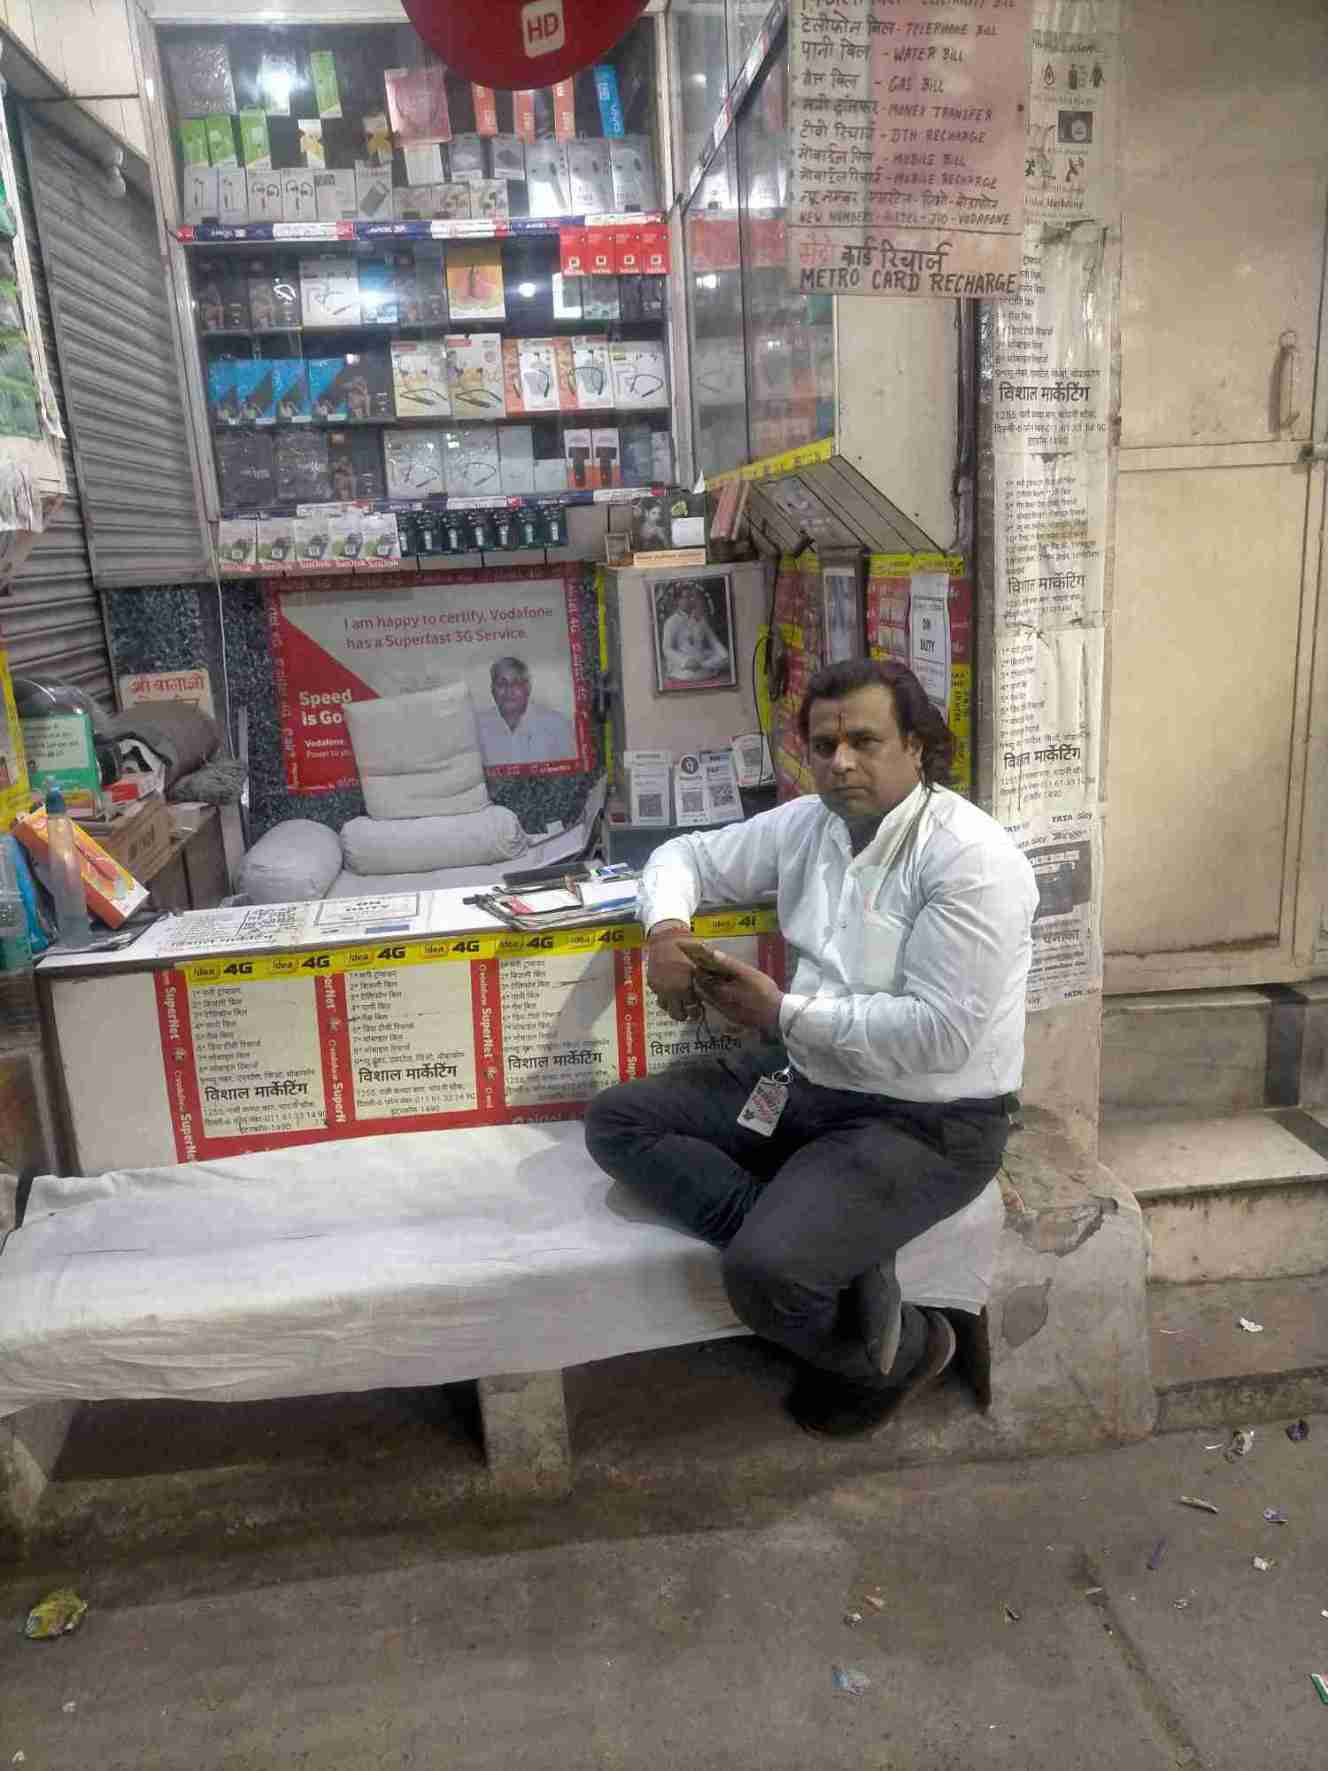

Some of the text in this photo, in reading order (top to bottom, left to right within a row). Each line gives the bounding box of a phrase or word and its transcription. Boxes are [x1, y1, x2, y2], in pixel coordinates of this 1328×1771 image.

[528, 12, 559, 44] HD
[801, 36, 834, 60] पानी
[893, 45, 964, 62] WATER BILL
[887, 75, 945, 94] GAS BILL
[889, 127, 987, 145] DTH RECHARGE
[800, 210, 822, 223] NEW
[957, 212, 1011, 226] VODAFONE
[800, 267, 860, 290] METRO
[872, 269, 921, 292] CARD
[928, 271, 1018, 295] RECHARGE
[999, 381, 1090, 401] विशाल मार्केटिंग
[344, 617, 349, 632] I
[352, 619, 374, 631] am
[377, 614, 418, 630] happy
[423, 615, 437, 626] to
[489, 606, 553, 622] Vodafone
[345, 637, 372, 649] has
[375, 640, 383, 649] a
[384, 631, 451, 649] Superfast
[455, 631, 474, 643] 3G
[299, 688, 352, 708] Speed
[301, 710, 343, 727] Is Go
[527, 936, 554, 949] 4G
[599, 929, 624, 943] 4G
[377, 947, 407, 960] 4G
[452, 940, 480, 953] 4G
[223, 961, 253, 975] 4G
[301, 956, 331, 970] 4G
[324, 974, 337, 1010] erNet
[164, 986, 181, 1041] SuperNet
[481, 1007, 494, 1058] SuperNet
[651, 1040, 690, 1056] विशाल
[508, 1049, 602, 1071] विशाल मार्केटिंग
[359, 1062, 457, 1083] विशाल मार्केटिंग
[205, 1085, 249, 1101] विशाल
[255, 1079, 308, 1098] मार्केटिंग
[333, 1082, 348, 1124] SuperN
[180, 1111, 198, 1162] SuperNe
